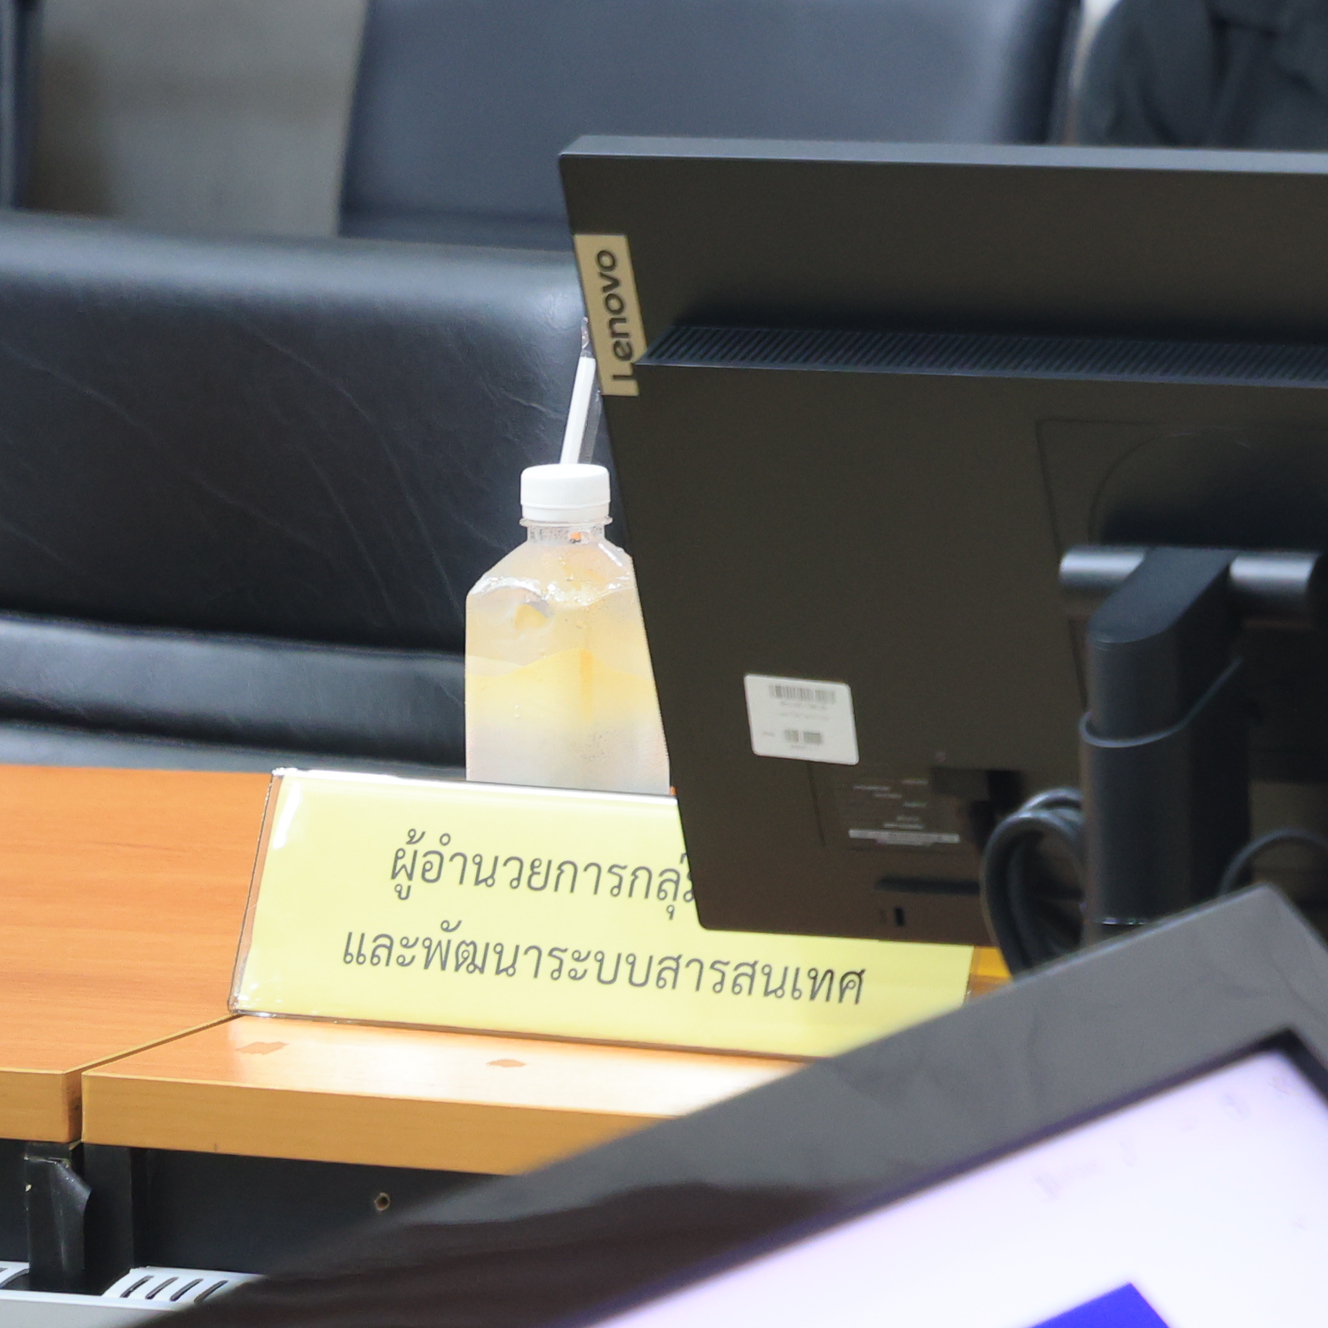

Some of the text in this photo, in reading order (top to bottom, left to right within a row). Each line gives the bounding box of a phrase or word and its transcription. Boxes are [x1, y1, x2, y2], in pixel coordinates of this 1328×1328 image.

[596, 249, 634, 381] Lenovo
[390, 828, 695, 921] ผู้อำนวยการกลุ่
[342, 919, 867, 1006] และพัฒนาระบบสารสนเทศ
